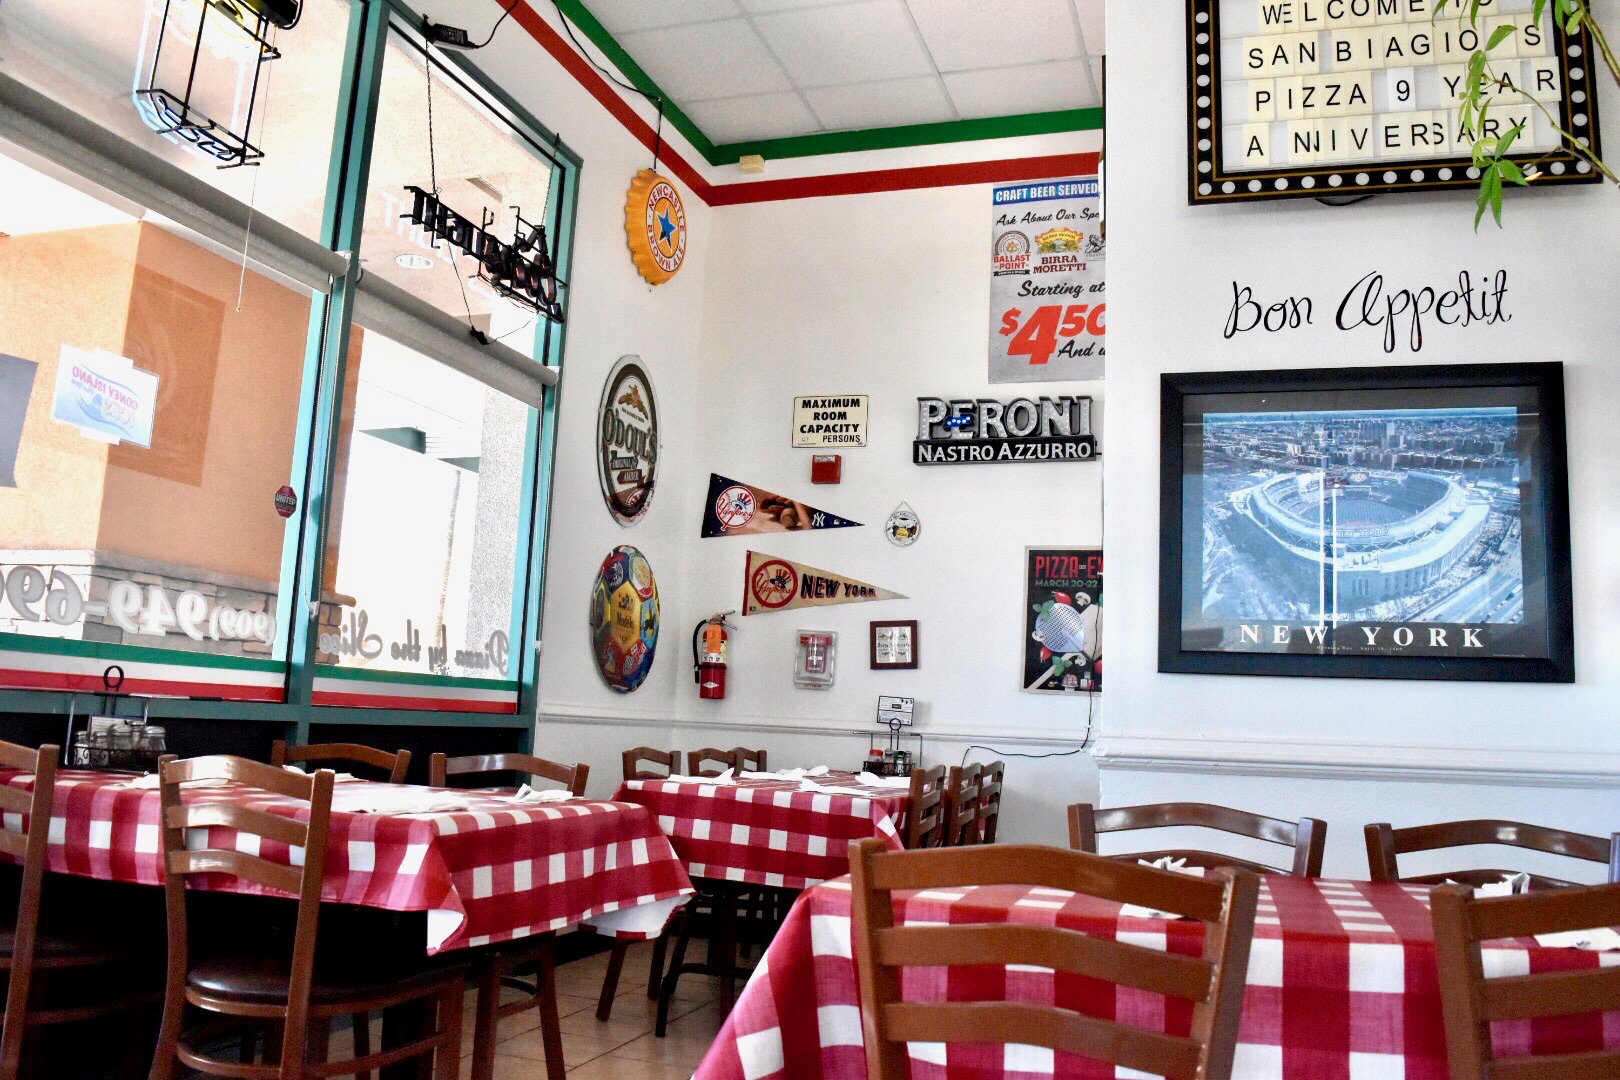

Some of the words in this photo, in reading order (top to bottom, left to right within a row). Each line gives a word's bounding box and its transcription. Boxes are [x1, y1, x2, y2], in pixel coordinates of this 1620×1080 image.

[1248, 41, 1316, 69] SAN
[1256, 84, 1366, 112] PIZZA
[1396, 80, 1411, 102] 9
[995, 187, 1029, 202] CRAFT
[1030, 184, 1056, 199] BEER
[1058, 182, 1098, 197] SERVED
[649, 185, 685, 231] NEWCASTLE
[995, 213, 1018, 226] Ask
[1020, 210, 1053, 224] About
[1055, 208, 1077, 221] Our
[647, 224, 671, 270] BROWN
[673, 247, 684, 269] ALE
[993, 253, 1032, 264] BALLAST
[999, 262, 1028, 270] POINT
[1033, 262, 1087, 274] MORETTI
[1041, 254, 1078, 265] BIRRA
[1017, 279, 1085, 298] Starting
[1089, 281, 1105, 293] at
[1223, 281, 1313, 339] Bon
[1335, 269, 1512, 353] Appetit
[1057, 339, 1094, 359] And
[801, 398, 861, 409] MAXIMUM
[813, 411, 847, 421] ROOM
[917, 396, 1093, 440] PERONI
[602, 407, 658, 465] O'DOUL'S
[799, 423, 860, 434] CAPACITY
[822, 434, 861, 443] PERSONS
[917, 444, 994, 463] NASTRO
[997, 441, 1091, 460] AZZURRO
[275, 493, 296, 506] UNITED
[800, 573, 841, 599] NEW
[843, 583, 877, 598] YORK
[1035, 579, 1069, 587] MARCH
[1240, 623, 1329, 646] NEW
[1361, 626, 1485, 649] YORK
